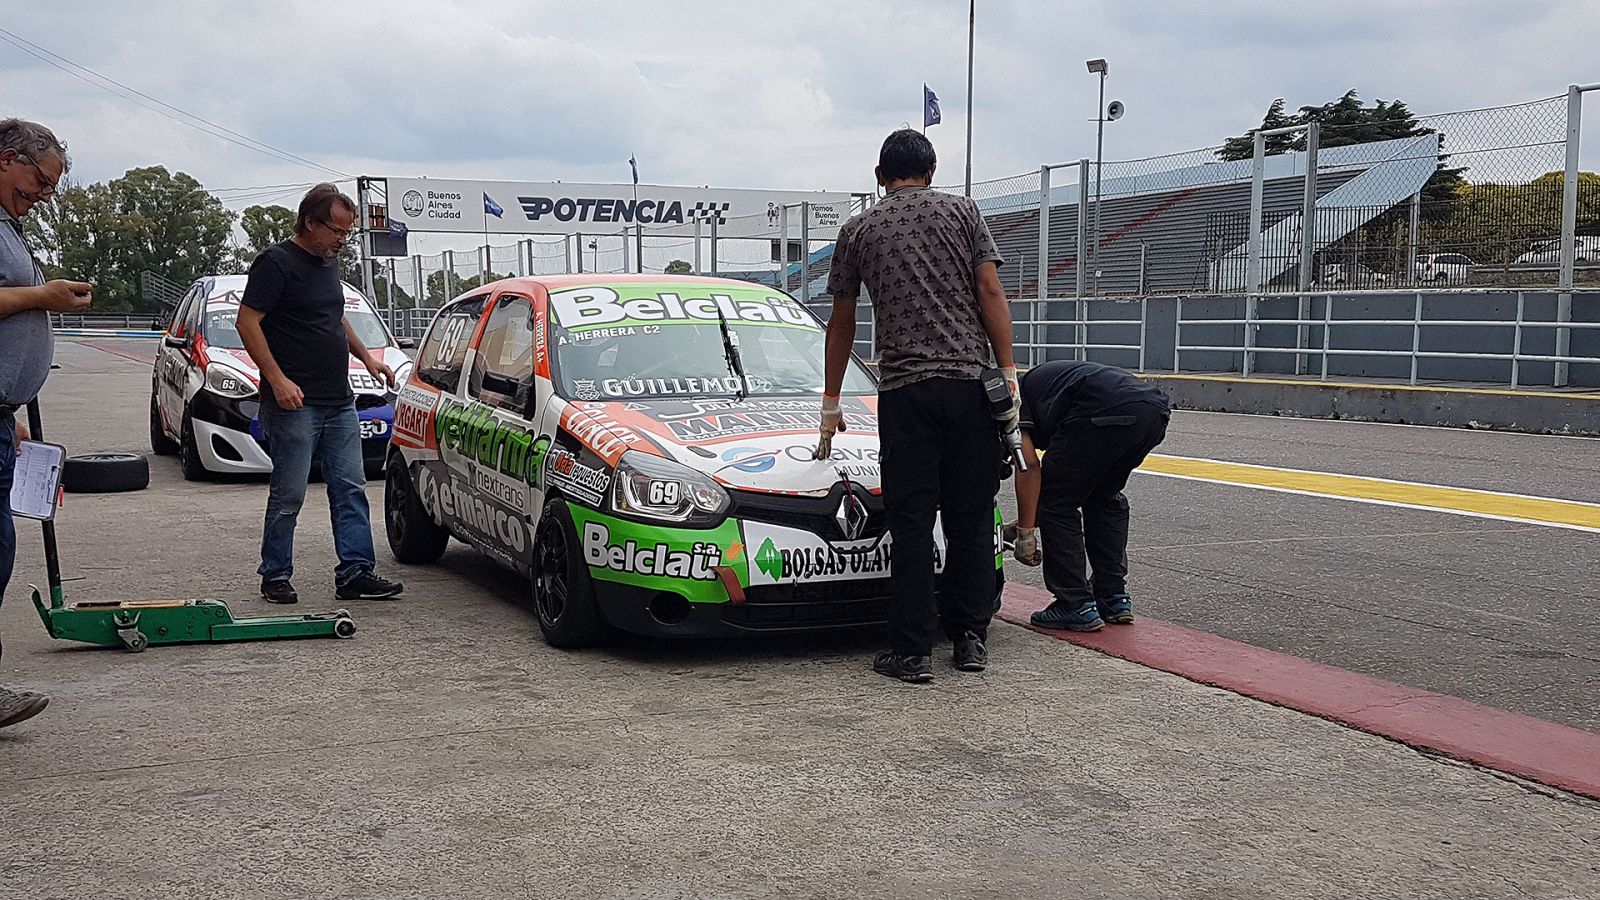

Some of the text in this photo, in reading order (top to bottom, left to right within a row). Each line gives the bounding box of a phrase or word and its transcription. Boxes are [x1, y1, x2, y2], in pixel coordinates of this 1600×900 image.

[428, 191, 461, 200] Buenos
[428, 200, 453, 209] Aires
[517, 196, 684, 224] POTENCIA
[811, 203, 833, 212] Vamos
[428, 210, 461, 219] Ciudad
[815, 211, 839, 219] Buenos
[552, 286, 822, 330] Belclau
[437, 317, 465, 363] 69
[575, 326, 636, 343] HERRERA
[643, 325, 661, 335] C2
[221, 379, 236, 391] 65
[477, 469, 523, 508] nextrans
[651, 482, 680, 504] 69
[583, 520, 720, 580] Belclau
[692, 542, 721, 556] s.a.
